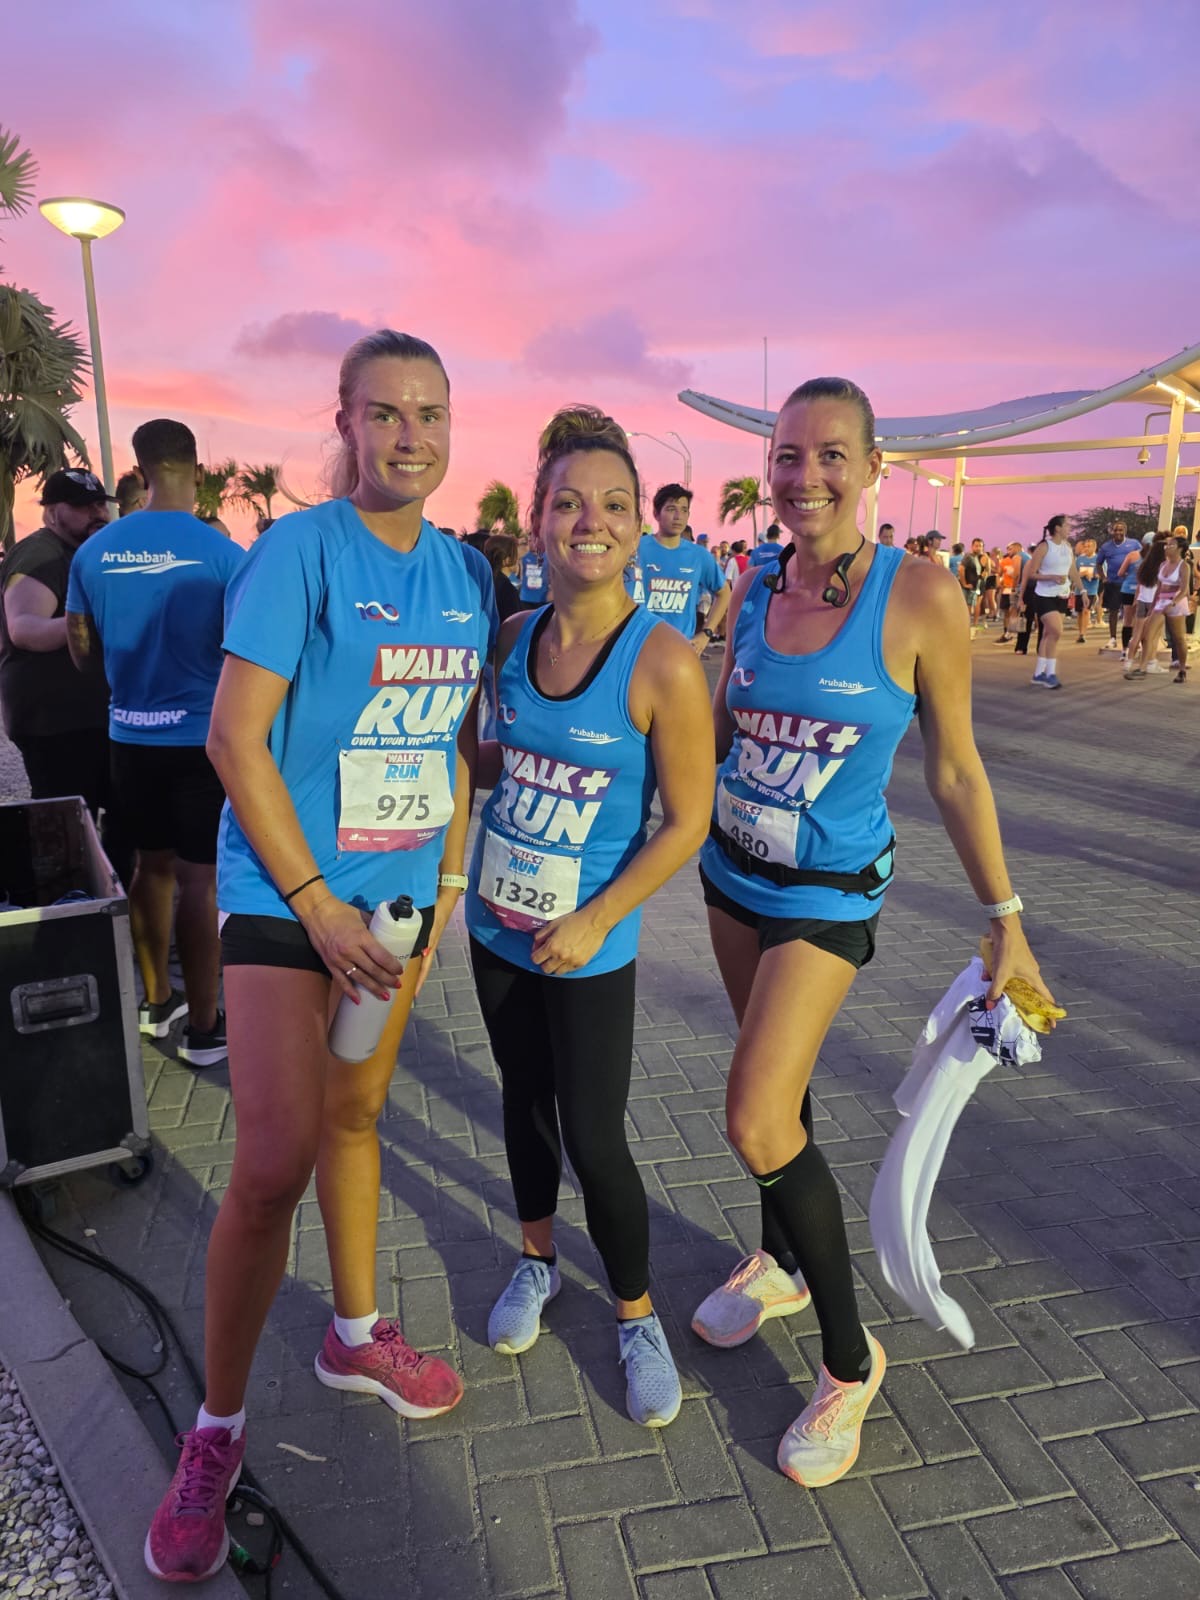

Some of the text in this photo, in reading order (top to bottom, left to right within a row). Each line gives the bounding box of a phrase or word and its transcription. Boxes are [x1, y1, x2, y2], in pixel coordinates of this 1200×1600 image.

[101, 550, 177, 563] Arubabank
[651, 578, 692, 592] WALK+
[647, 591, 689, 609] RUN
[355, 600, 399, 621] 100
[380, 648, 480, 681] WALK+
[818, 677, 865, 690] Arubabank
[113, 708, 188, 726] SUBWAY
[353, 686, 475, 736] RUN
[351, 736, 377, 746] OWN
[380, 736, 406, 746] YOUR
[568, 726, 612, 741] Arubabank
[732, 710, 862, 754] WALK+
[387, 753, 423, 764] WALK+
[385, 764, 420, 779] RUN
[501, 746, 612, 796] WALK+
[738, 737, 846, 803] RUN
[376, 794, 430, 821] 975
[492, 775, 602, 845] RUN
[731, 806, 760, 826] RUN
[730, 824, 769, 858] 480
[511, 846, 544, 865] WALK+
[508, 857, 541, 876] RUN
[494, 877, 557, 914] 1328
